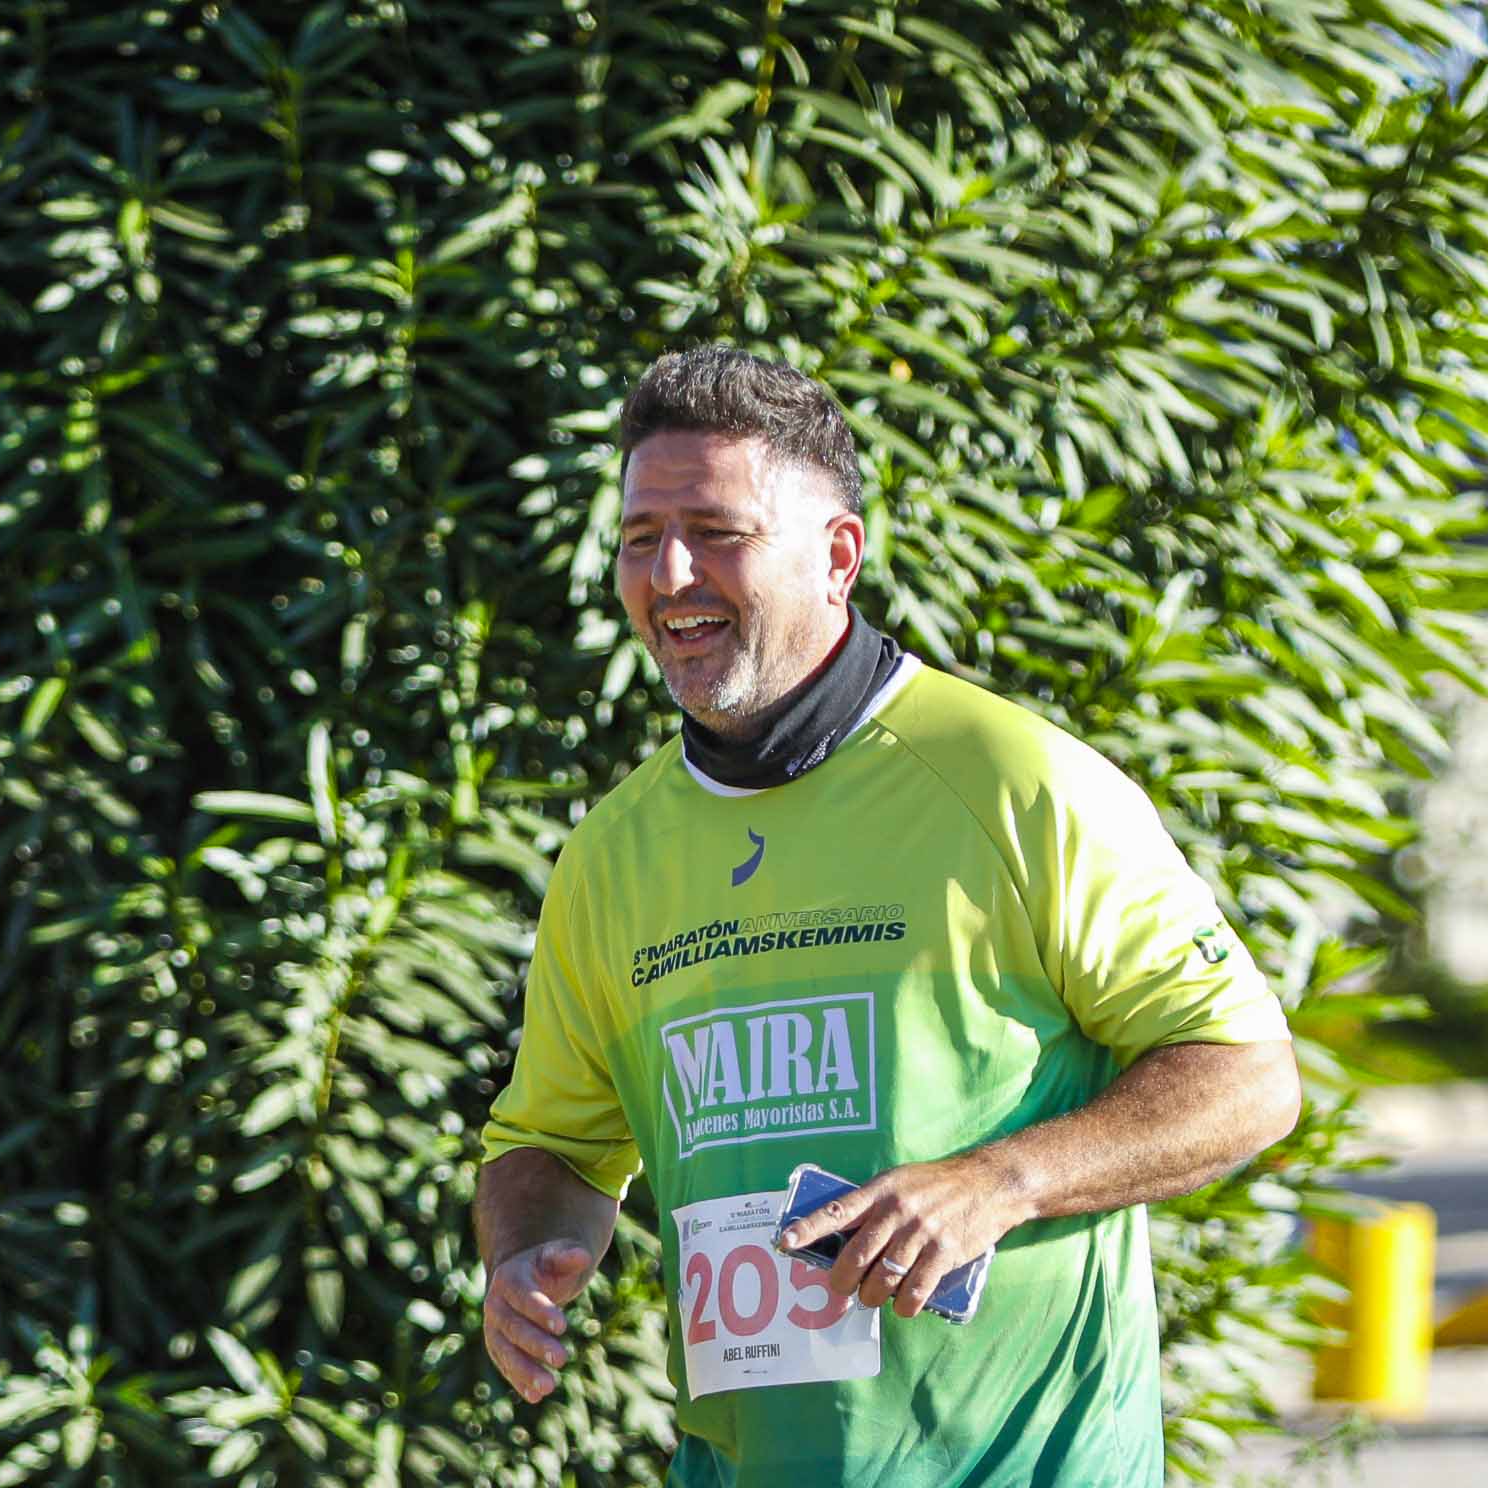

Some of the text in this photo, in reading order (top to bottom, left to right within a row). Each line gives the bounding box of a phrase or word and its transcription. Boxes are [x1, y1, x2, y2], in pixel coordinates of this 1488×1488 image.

[666, 1007, 860, 1117] MAIRA
[743, 1100, 825, 1132] Mayoristas
[828, 1097, 861, 1120] S.A.
[685, 1243, 850, 1346] 205
[722, 1343, 781, 1363] ABEL RUFFINI
